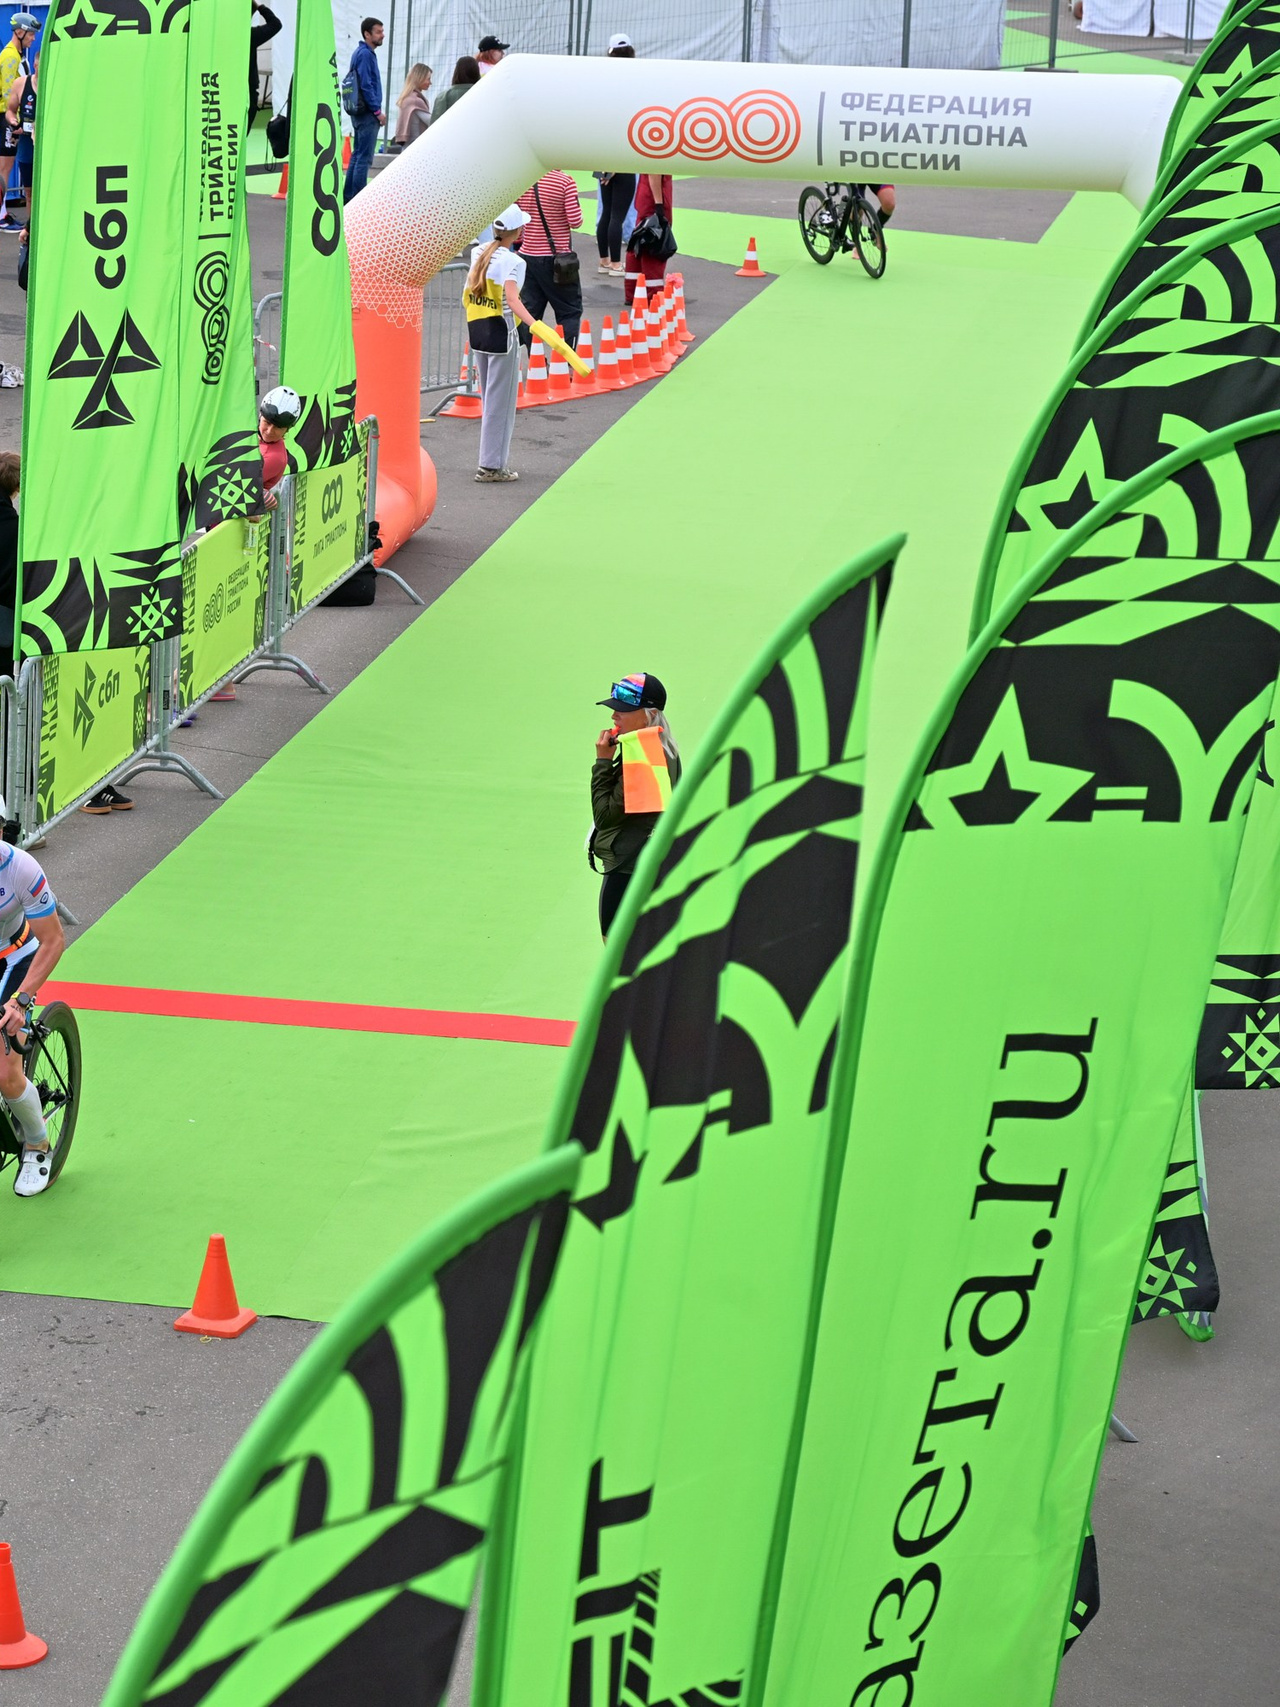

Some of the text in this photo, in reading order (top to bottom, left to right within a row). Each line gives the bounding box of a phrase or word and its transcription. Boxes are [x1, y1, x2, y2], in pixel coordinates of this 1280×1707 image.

[839, 120, 1029, 148] ТРИАТЛОНА
[840, 91, 1033, 119] ФЕДЕРАЦИЯ
[208, 72, 224, 221] ТРИАТЛОНА
[227, 124, 238, 220] РОССИИ
[839, 151, 961, 172] РОССИИ
[84, 165, 128, 290] сбп
[98, 668, 120, 708] сбп
[847, 1017, 1099, 1707] азета.ru
